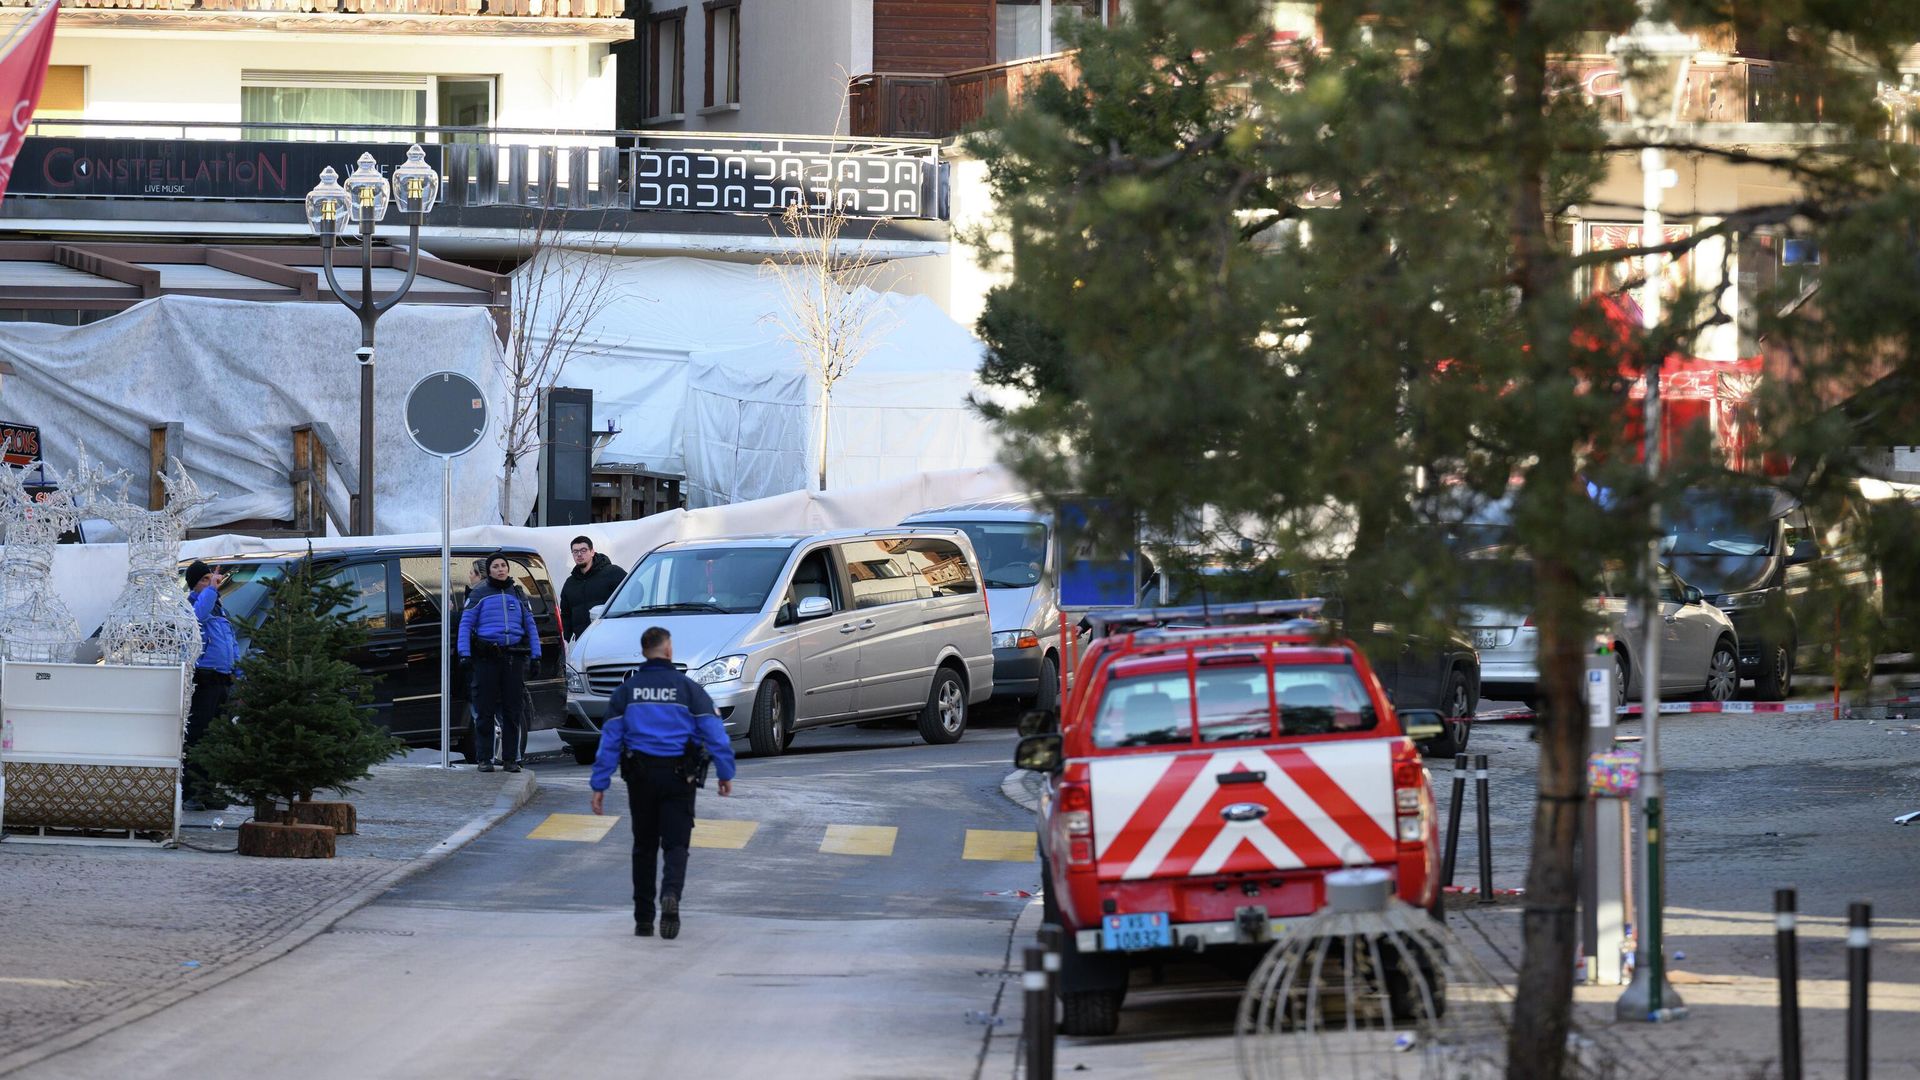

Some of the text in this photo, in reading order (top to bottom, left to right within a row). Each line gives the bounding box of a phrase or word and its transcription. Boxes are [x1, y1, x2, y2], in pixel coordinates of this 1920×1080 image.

[144, 184, 185, 193] LIVE MUSIC
[633, 687, 678, 701] POLICE
[1127, 914, 1145, 929] VS
[1114, 929, 1161, 950] 10832
